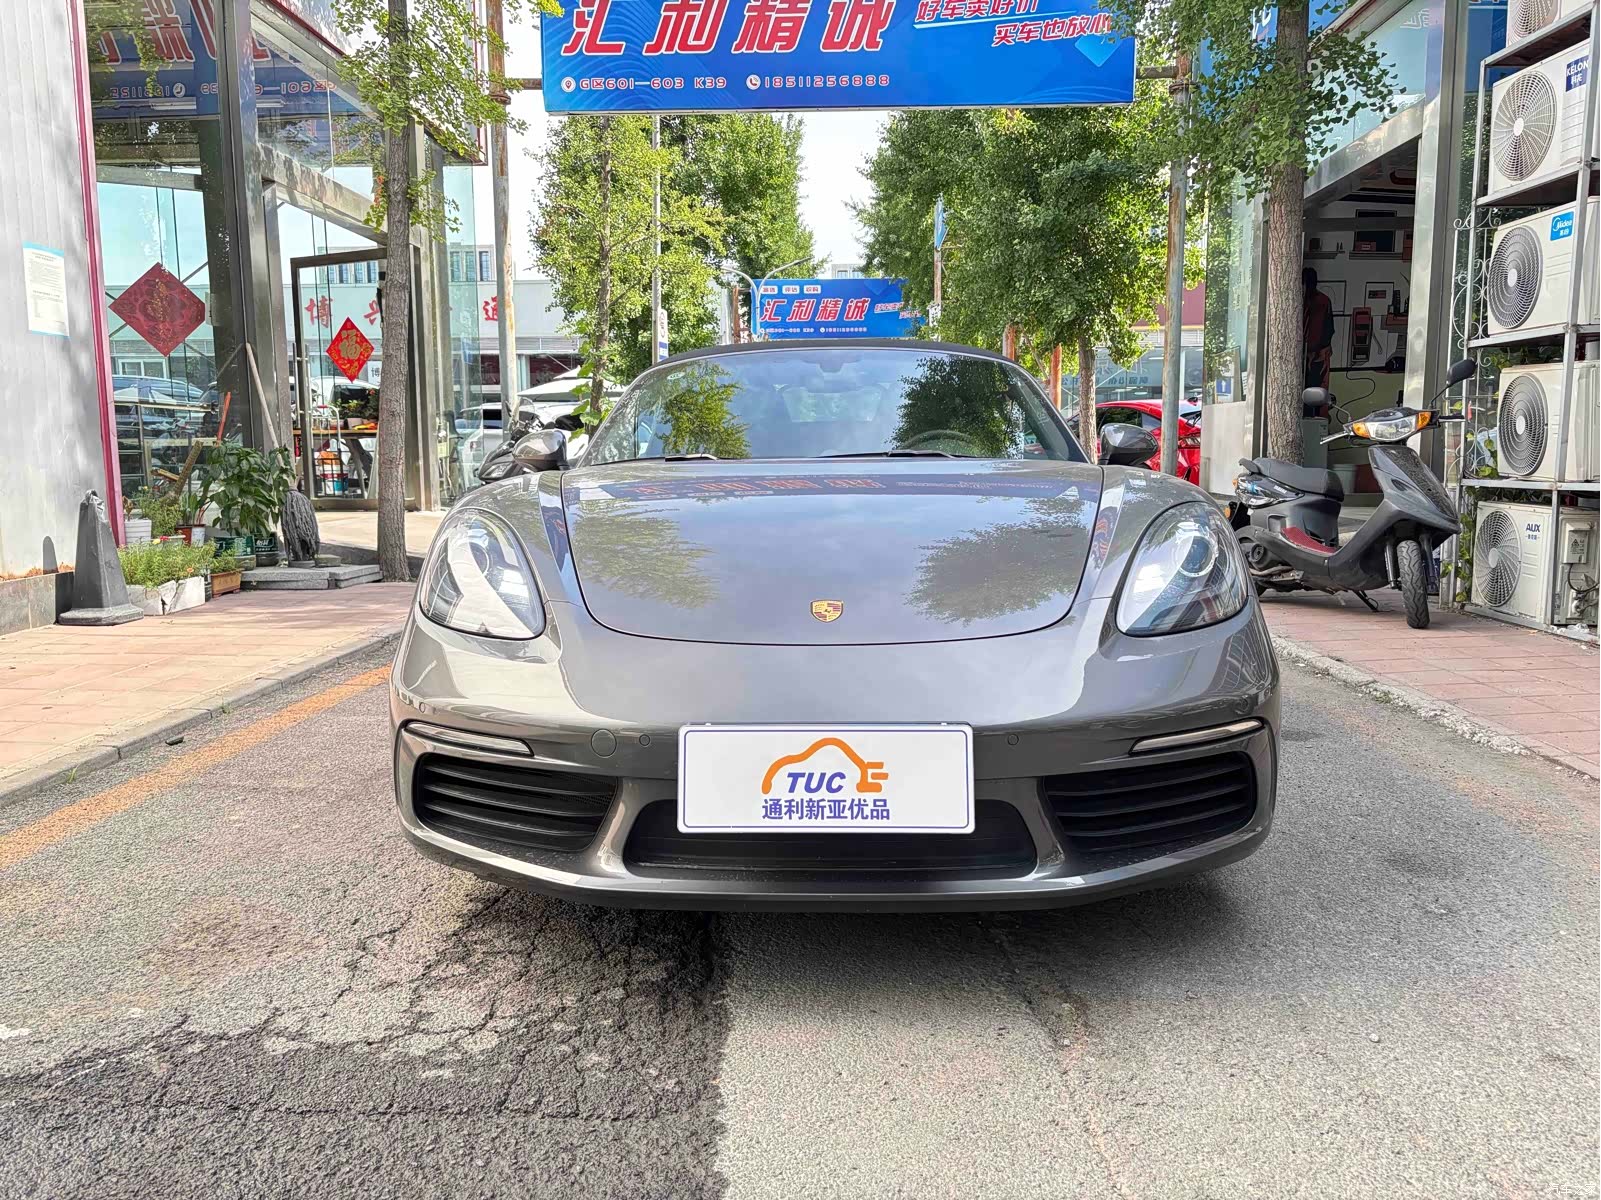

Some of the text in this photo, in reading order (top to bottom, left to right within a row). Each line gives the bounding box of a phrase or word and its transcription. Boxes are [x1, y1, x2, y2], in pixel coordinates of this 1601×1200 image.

[561, 0, 896, 55] 汇利精诚
[991, 13, 1113, 47] 买车也放心
[694, 77, 727, 89] K39
[764, 75, 890, 88] 18511256888
[760, 298, 871, 322] 汇利精诚
[1525, 523, 1540, 533] AUX
[787, 772, 846, 793] TUC
[761, 798, 890, 820] 通利新亚优品
